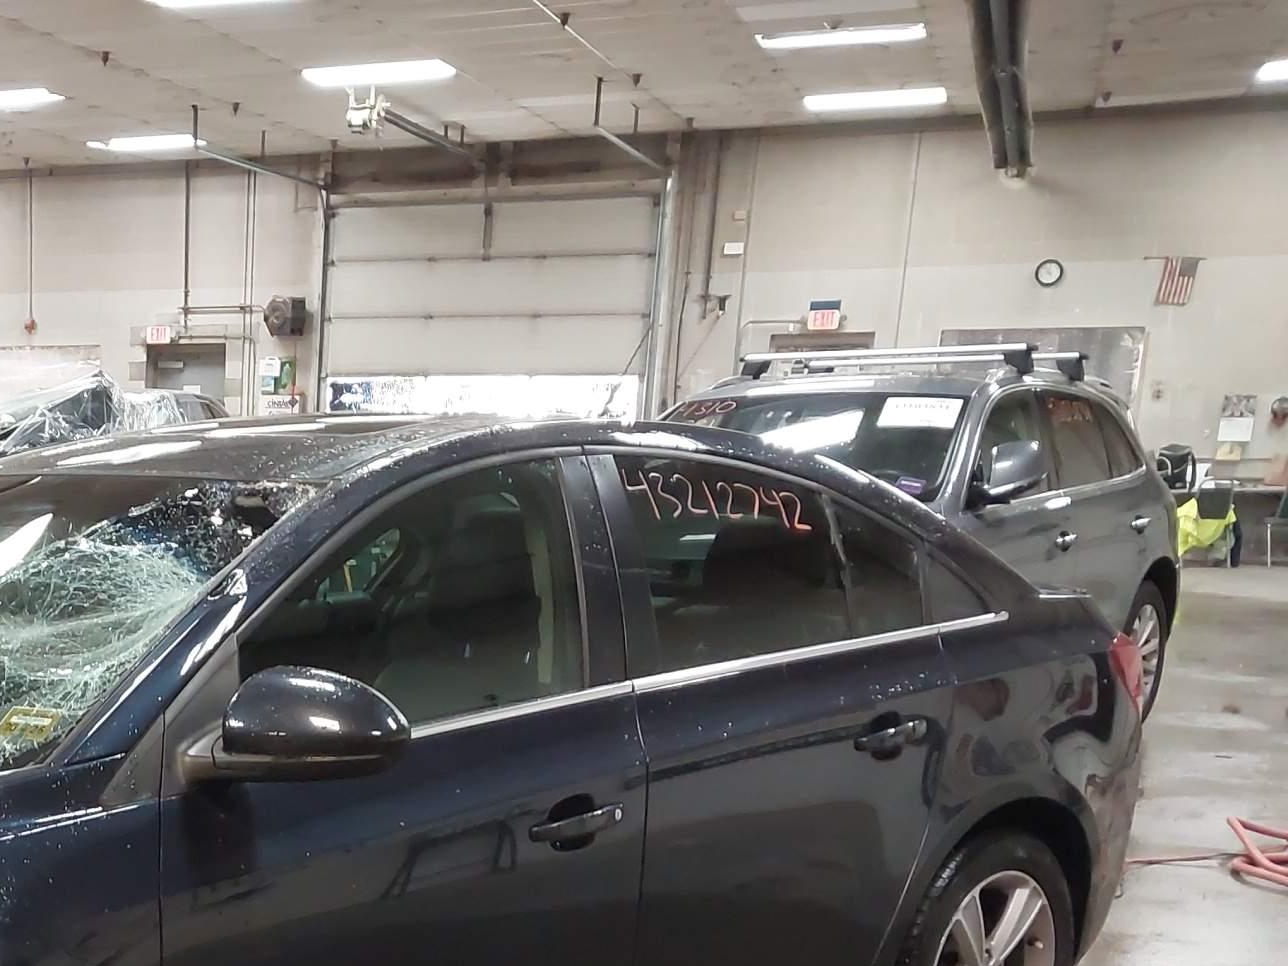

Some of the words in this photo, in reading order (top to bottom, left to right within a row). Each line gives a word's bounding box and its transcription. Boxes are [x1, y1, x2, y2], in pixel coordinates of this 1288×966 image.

[814, 311, 836, 328] EXIT
[151, 327, 167, 341] EXIT
[621, 468, 813, 531] 43212742
